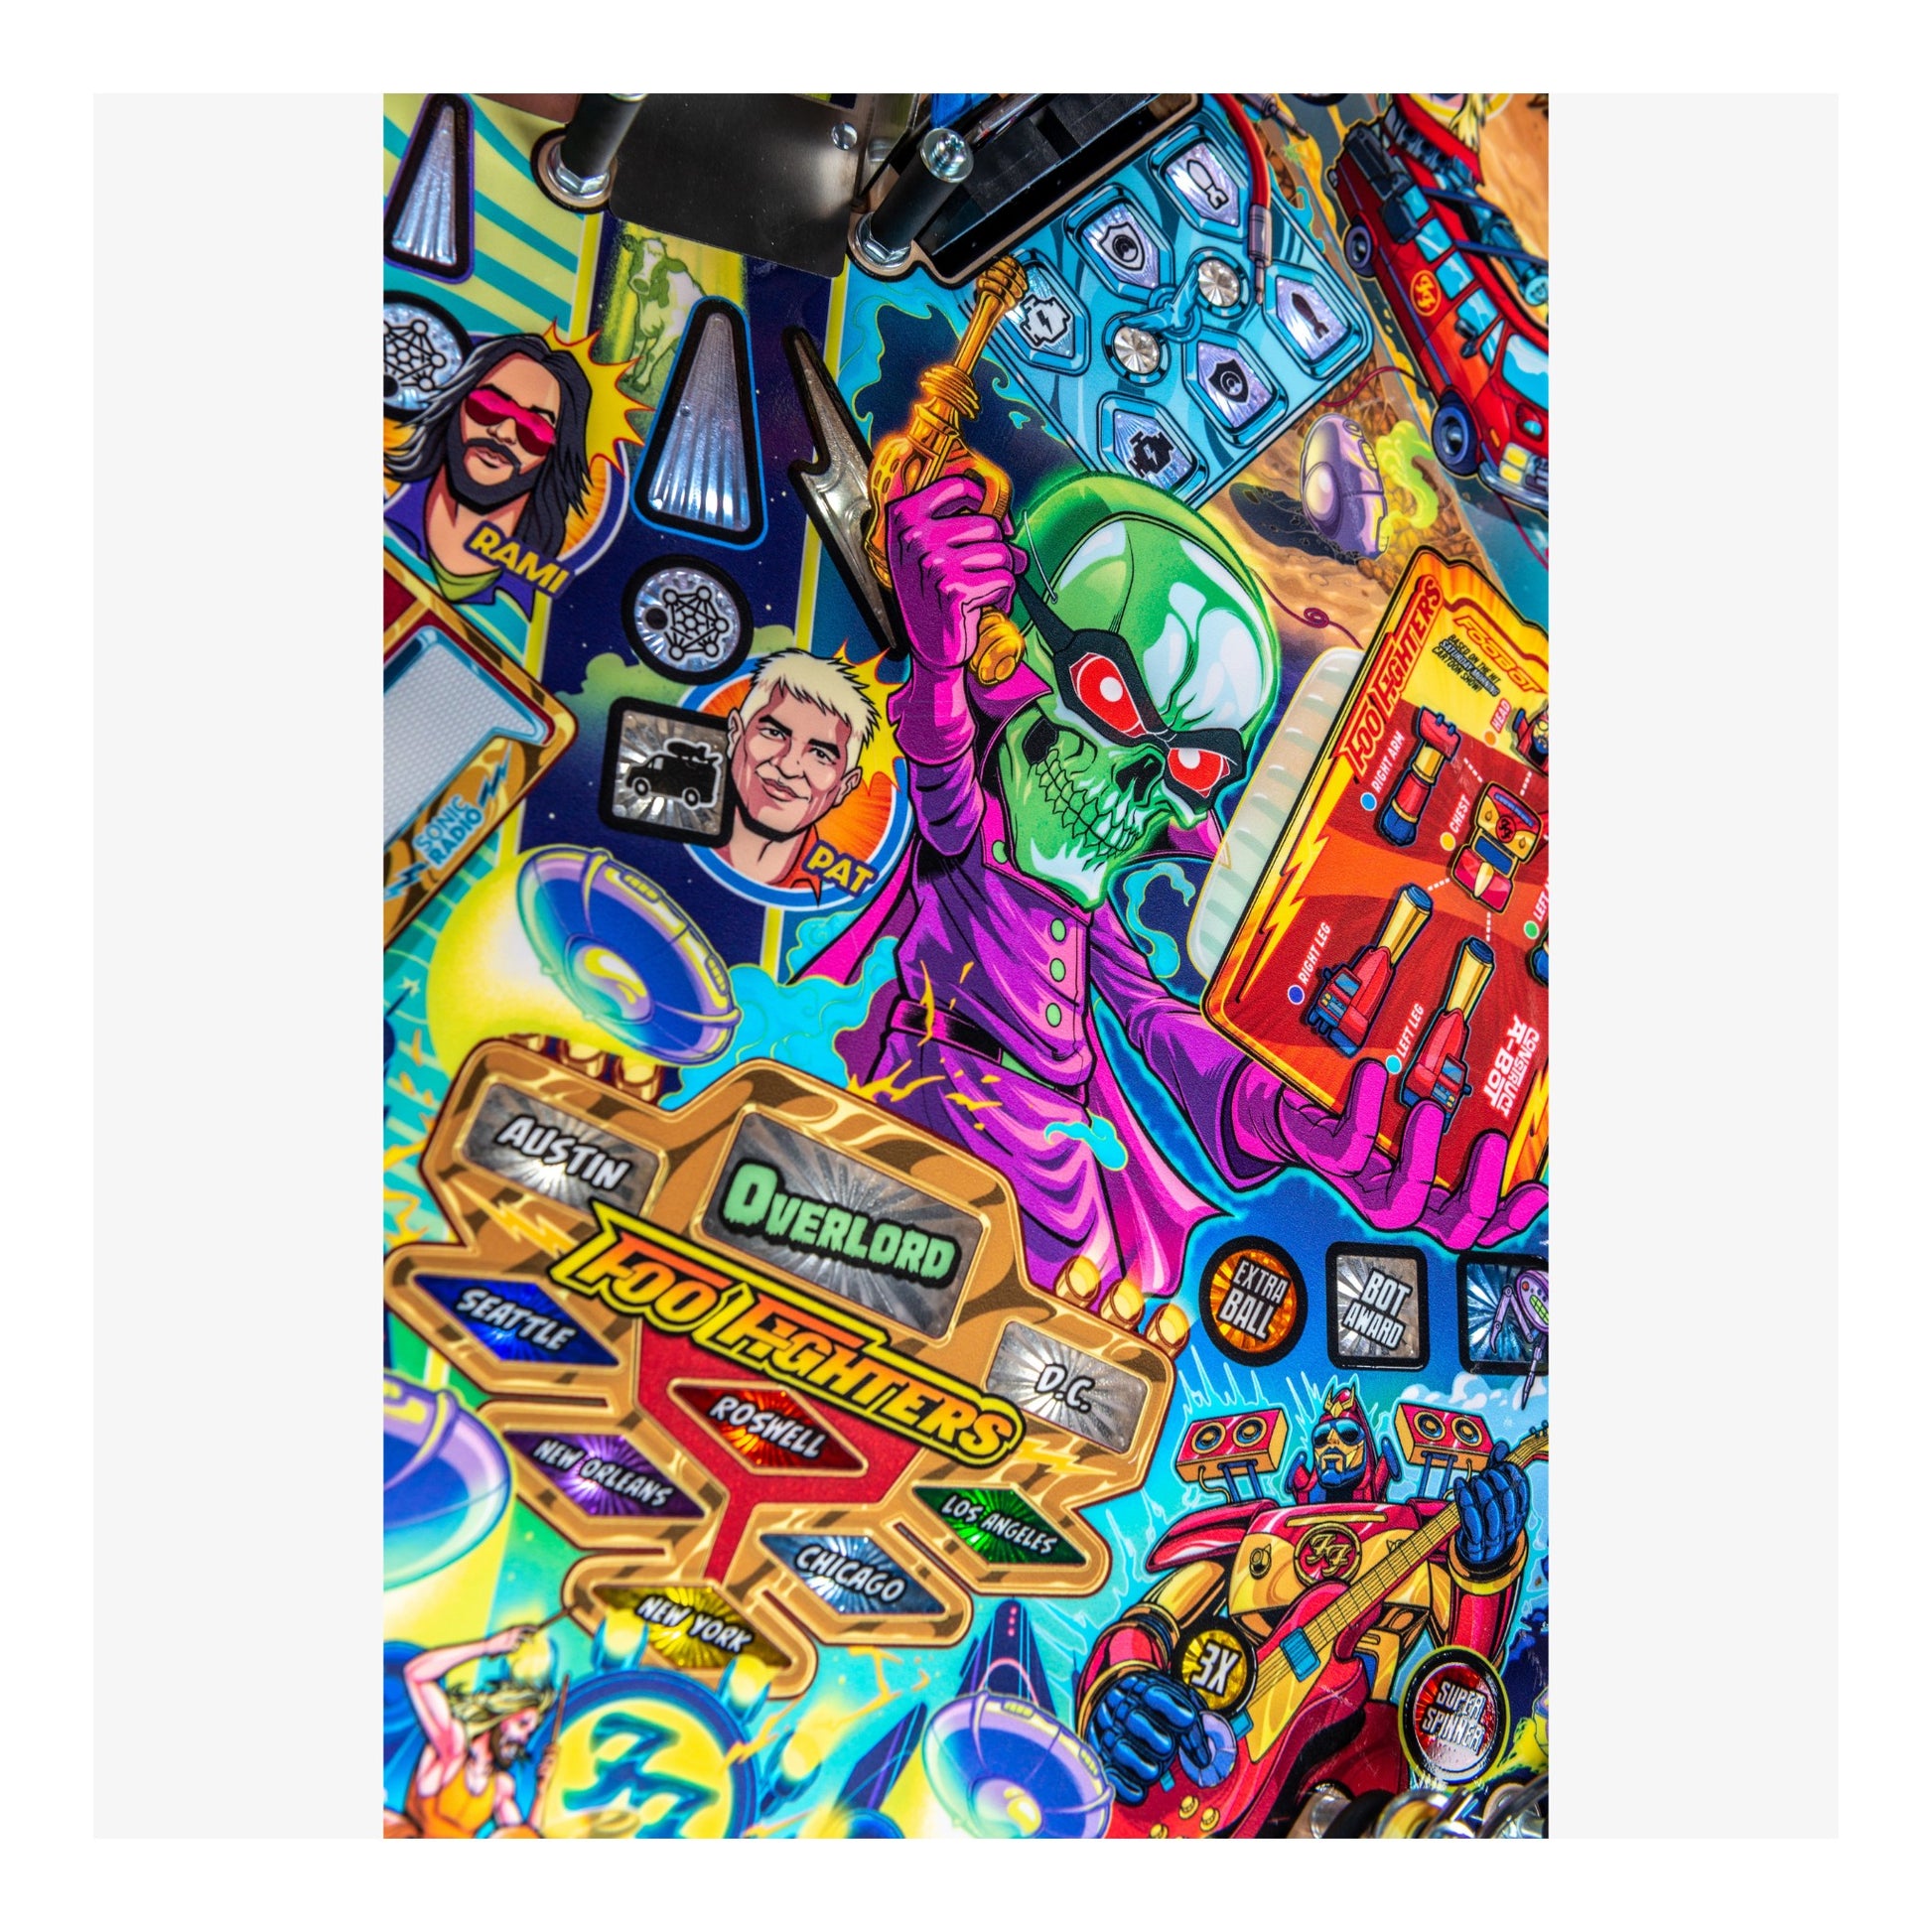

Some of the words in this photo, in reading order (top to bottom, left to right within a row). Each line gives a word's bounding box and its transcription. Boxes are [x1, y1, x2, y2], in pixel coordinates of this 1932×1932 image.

[470, 526, 570, 593] RAMI
[1338, 698, 1385, 777] FOO
[1370, 576, 1443, 717] FIGHTERS
[1432, 646, 1462, 675] CARTOON
[1441, 640, 1474, 670] SATURDAY
[1470, 668, 1499, 695] MORNING
[1448, 634, 1470, 654] BASED
[1468, 653, 1480, 664] ON
[1477, 661, 1491, 673] THE
[1489, 674, 1501, 684] HIT
[1491, 700, 1510, 732] HEAD
[1371, 756, 1393, 793] RIGHT
[1387, 731, 1405, 760] ARM
[415, 795, 469, 852] SONIC
[429, 808, 483, 865] RADIO
[1449, 795, 1470, 833] CHEST
[807, 845, 875, 894] PAT
[1298, 950, 1321, 985] RIGHT
[1314, 921, 1331, 952] LEG
[1396, 1028, 1415, 1057] LEFT
[1408, 1003, 1425, 1034] LEG
[1483, 1014, 1528, 1108] A-BOT
[1495, 1027, 1540, 1118] CONSTRUCT
[497, 1117, 629, 1189] AUSTIN
[723, 1163, 955, 1280] OVERLORD
[1234, 1260, 1289, 1303] EXTRA
[1361, 1271, 1411, 1314] BOT
[457, 1289, 576, 1350] SEATTLE
[568, 1219, 733, 1327] FOO
[711, 1290, 1017, 1459] FIGHTERS
[1219, 1290, 1275, 1340] BALL
[1344, 1306, 1404, 1349] AWARD
[1036, 1366, 1092, 1411] D.C.
[710, 1396, 826, 1457] ROSWELL
[533, 1439, 584, 1468] NEW
[581, 1456, 673, 1506] ORLEANS
[941, 1495, 983, 1522] LOS
[982, 1514, 1057, 1555] ANGELES
[796, 1547, 905, 1601] CHICAGO
[636, 1596, 691, 1626] NEW
[689, 1613, 753, 1653] YORK
[1191, 1641, 1240, 1696] 3X
[1437, 1681, 1487, 1722] SUPER
[1422, 1707, 1486, 1753] SPINNER
